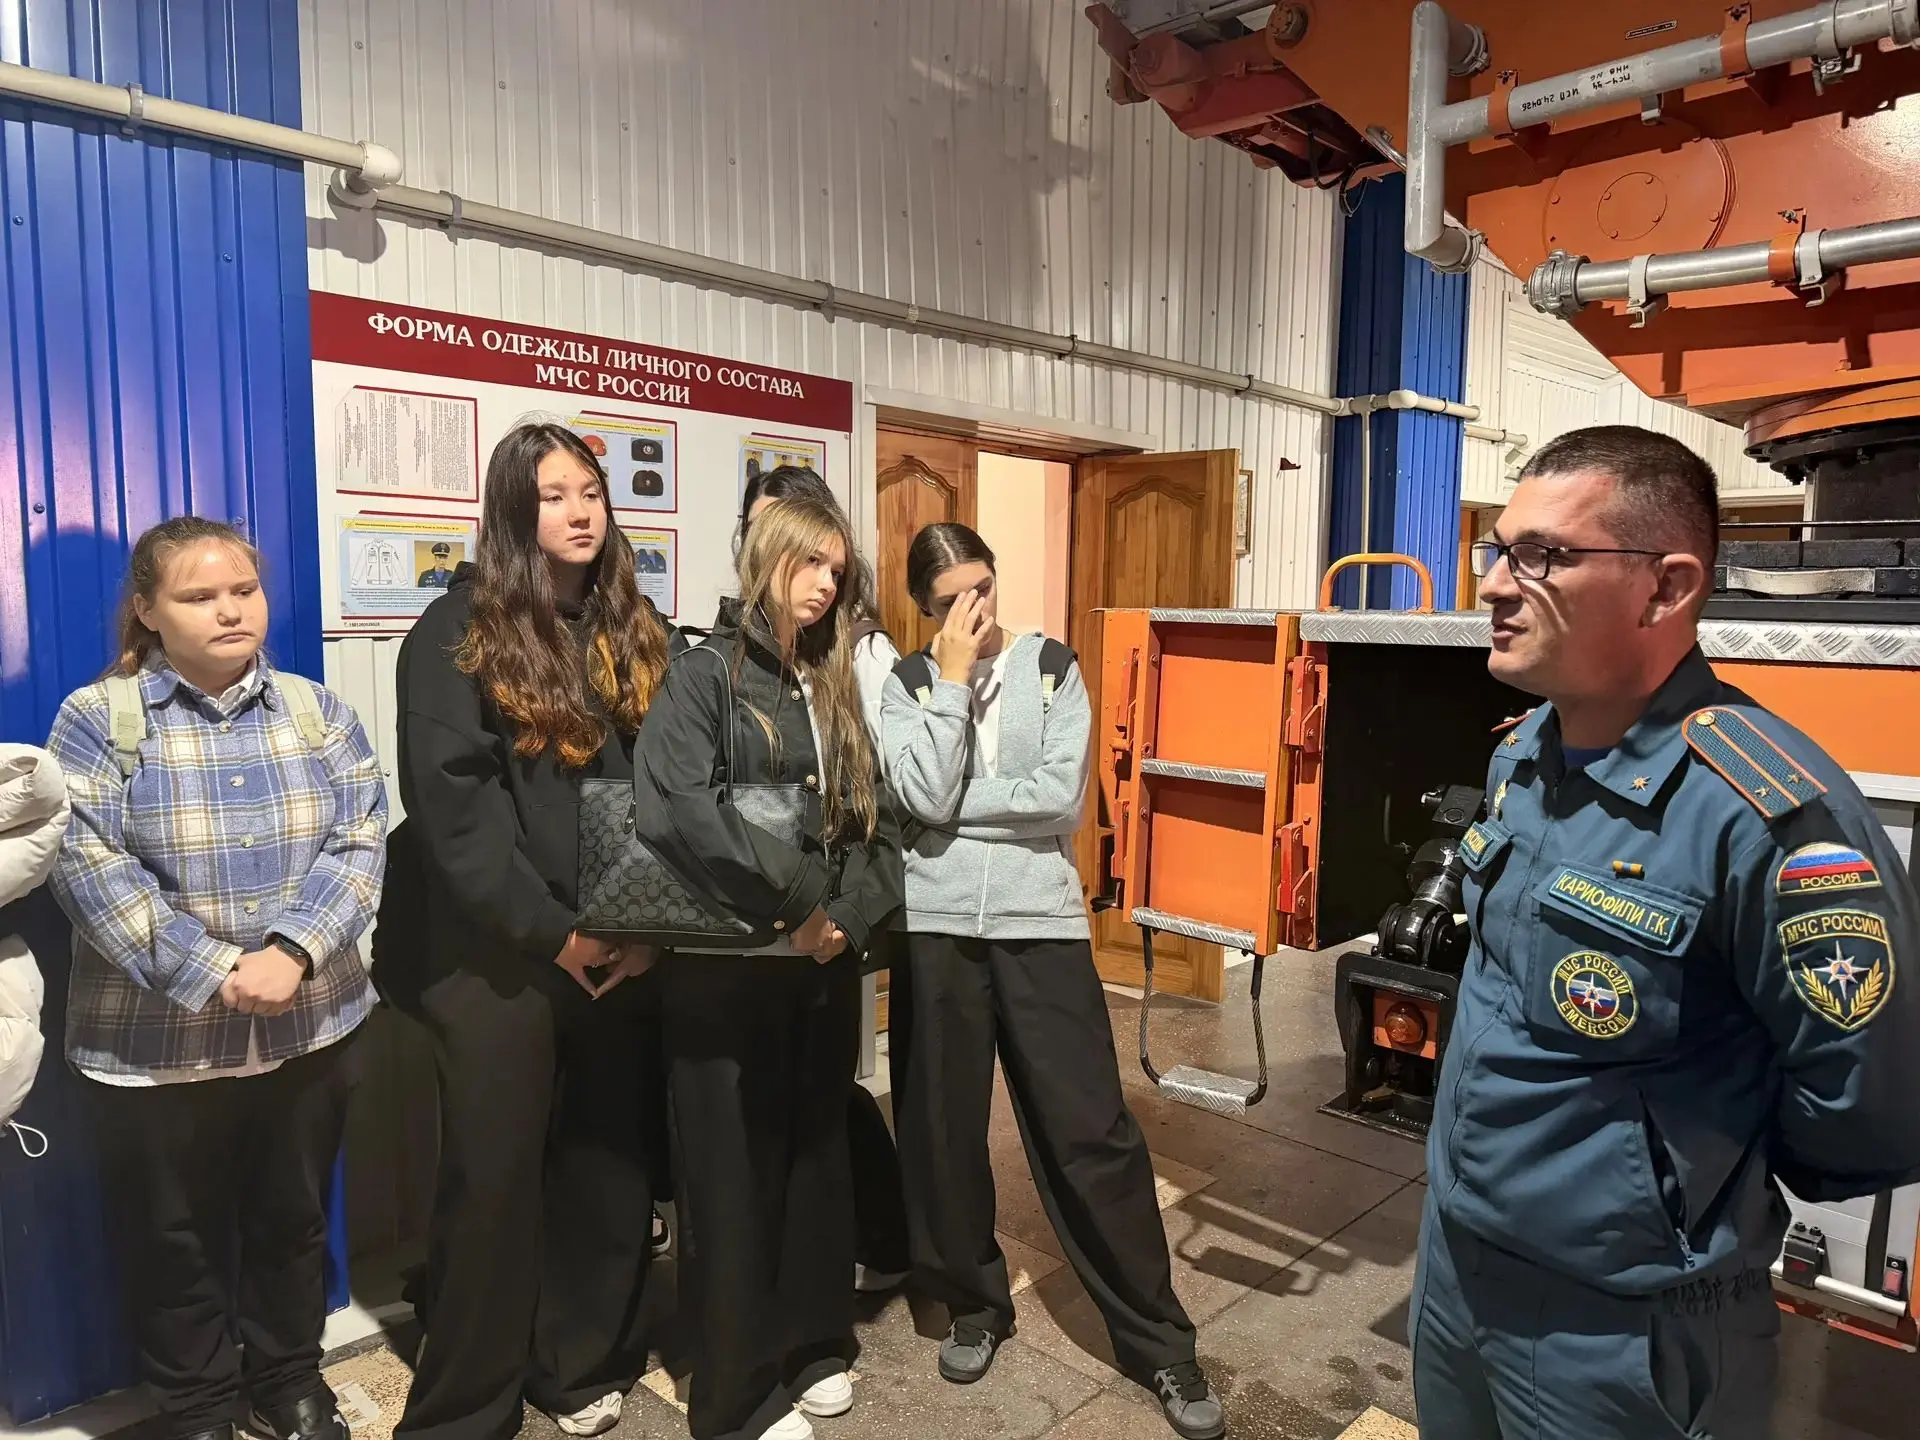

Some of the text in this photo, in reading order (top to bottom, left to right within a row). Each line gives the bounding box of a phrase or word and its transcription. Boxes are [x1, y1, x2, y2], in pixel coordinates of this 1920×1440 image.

[367, 312, 805, 399] ФОРМА ОДЕЖДЫ ЛИЧНОГО СОСТАВА
[535, 364, 690, 405] МЧС РОССИИ
[1800, 872, 1861, 888] РОССИЯ
[1556, 874, 1669, 936] КАРИОФИЛИ Г.К.
[1787, 915, 1882, 942] МЧС РОССИИ
[1557, 955, 1630, 995] МЧС РОССИИ
[1560, 1001, 1629, 1034] EMERCOM
